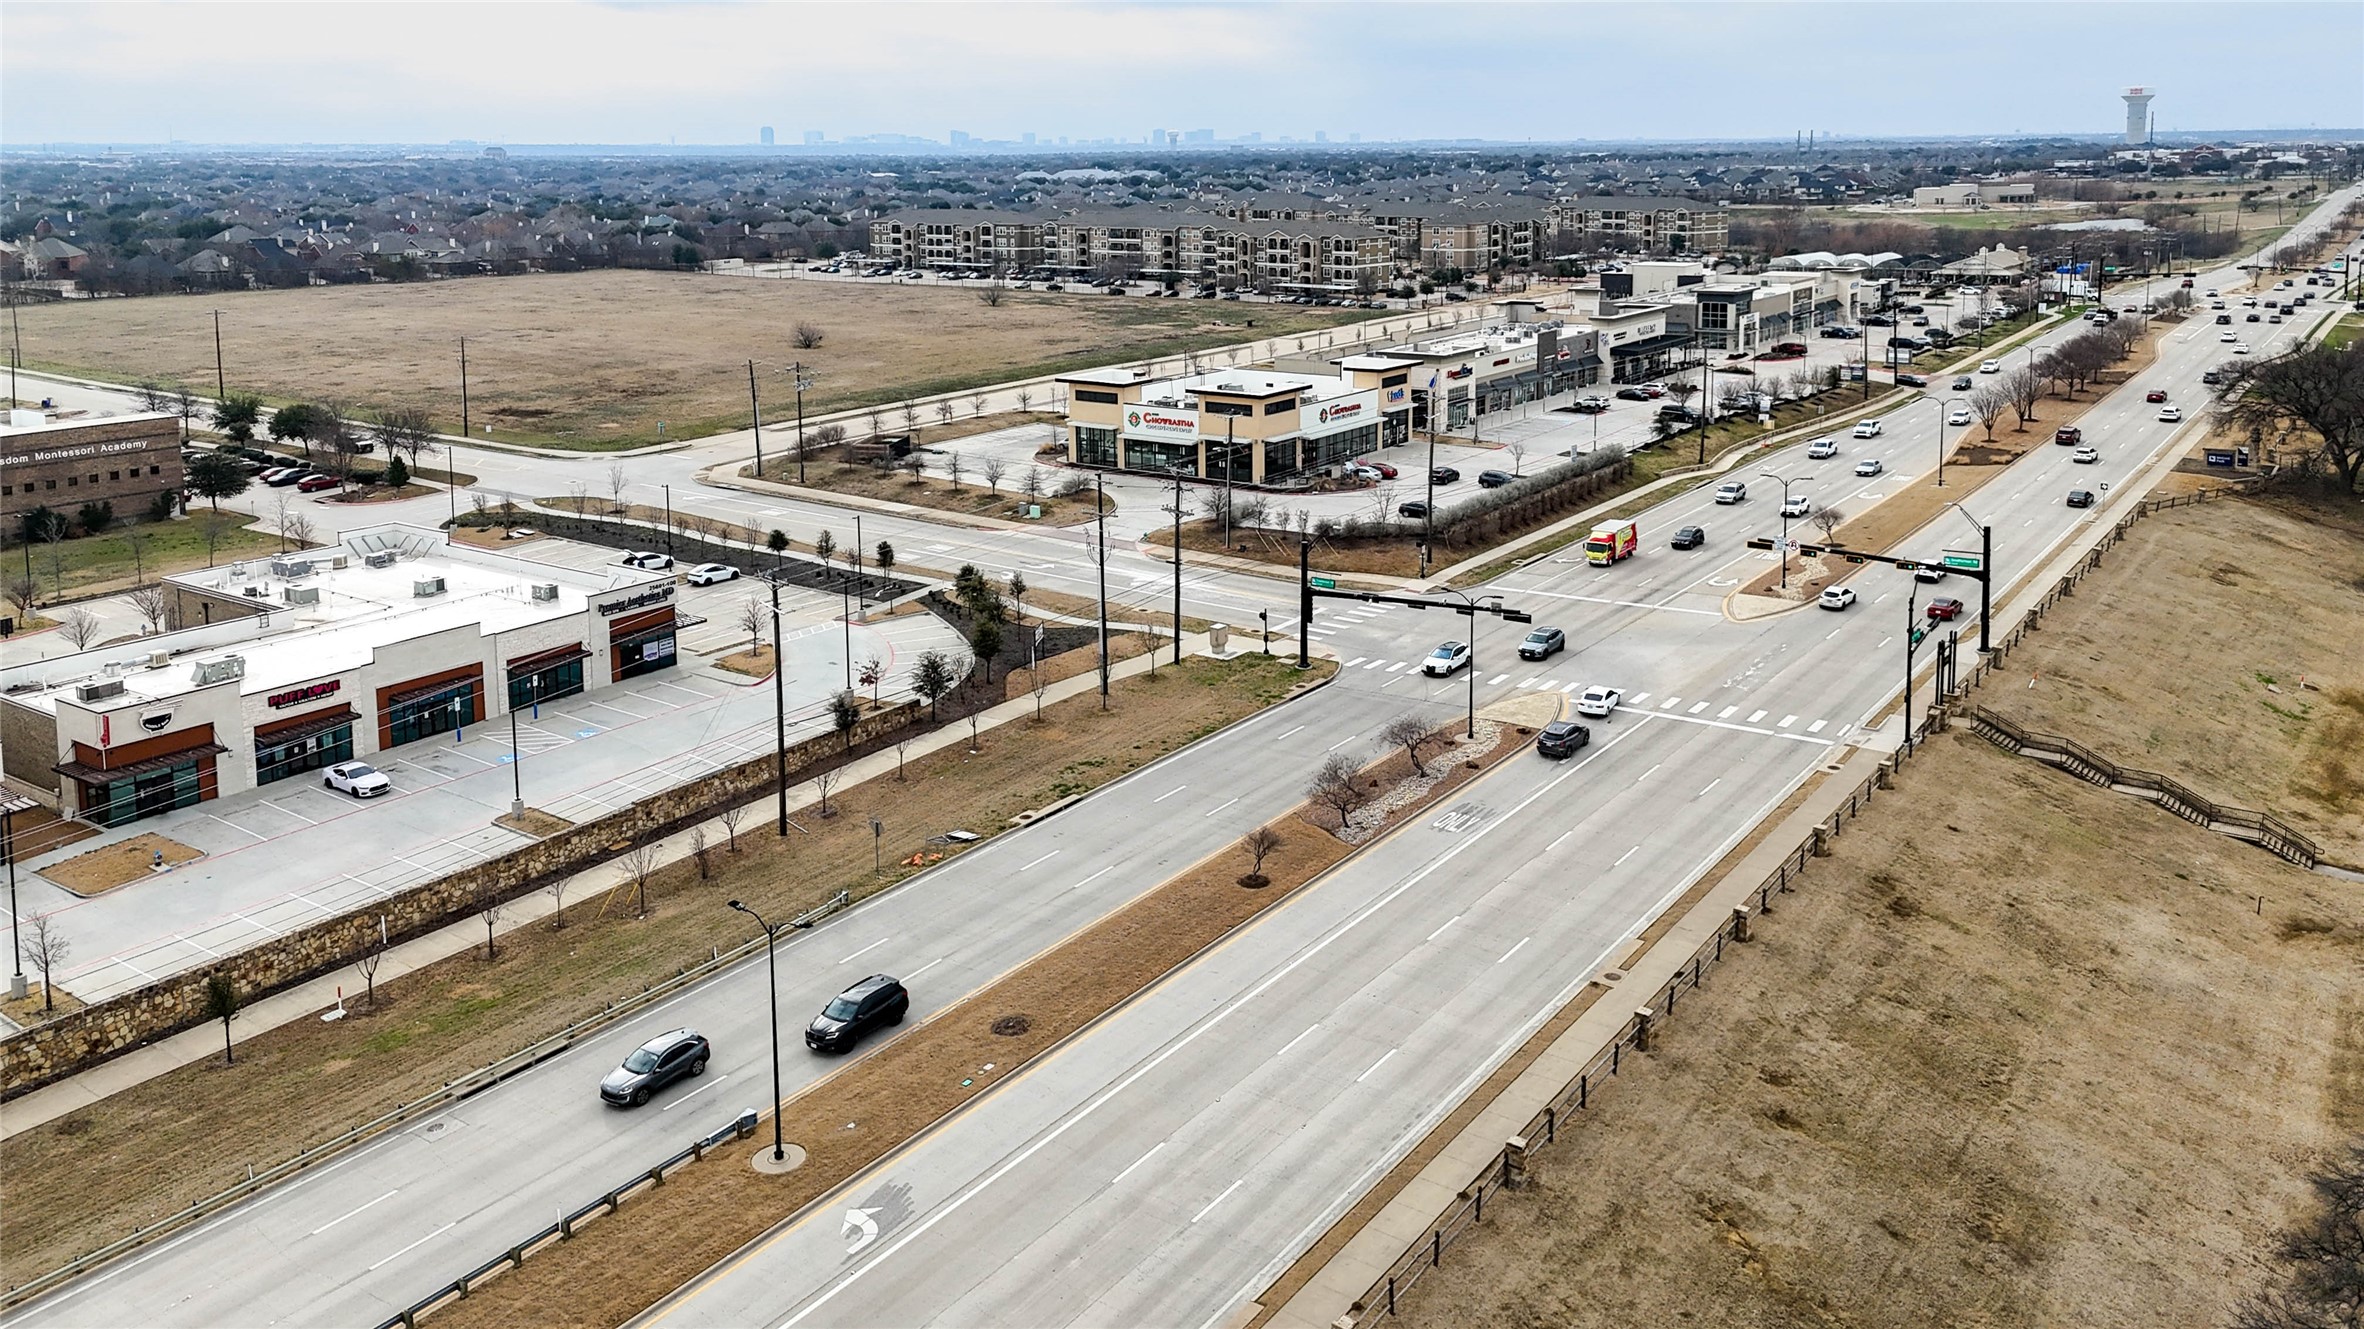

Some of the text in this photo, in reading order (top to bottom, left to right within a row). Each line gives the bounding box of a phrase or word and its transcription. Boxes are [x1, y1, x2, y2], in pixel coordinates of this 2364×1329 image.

[35, 446, 95, 461] Montessori
[100, 440, 148, 452] Academy
[661, 587, 674, 597] MD
[269, 689, 304, 706] PUFF
[1432, 811, 1481, 833] ONLY
